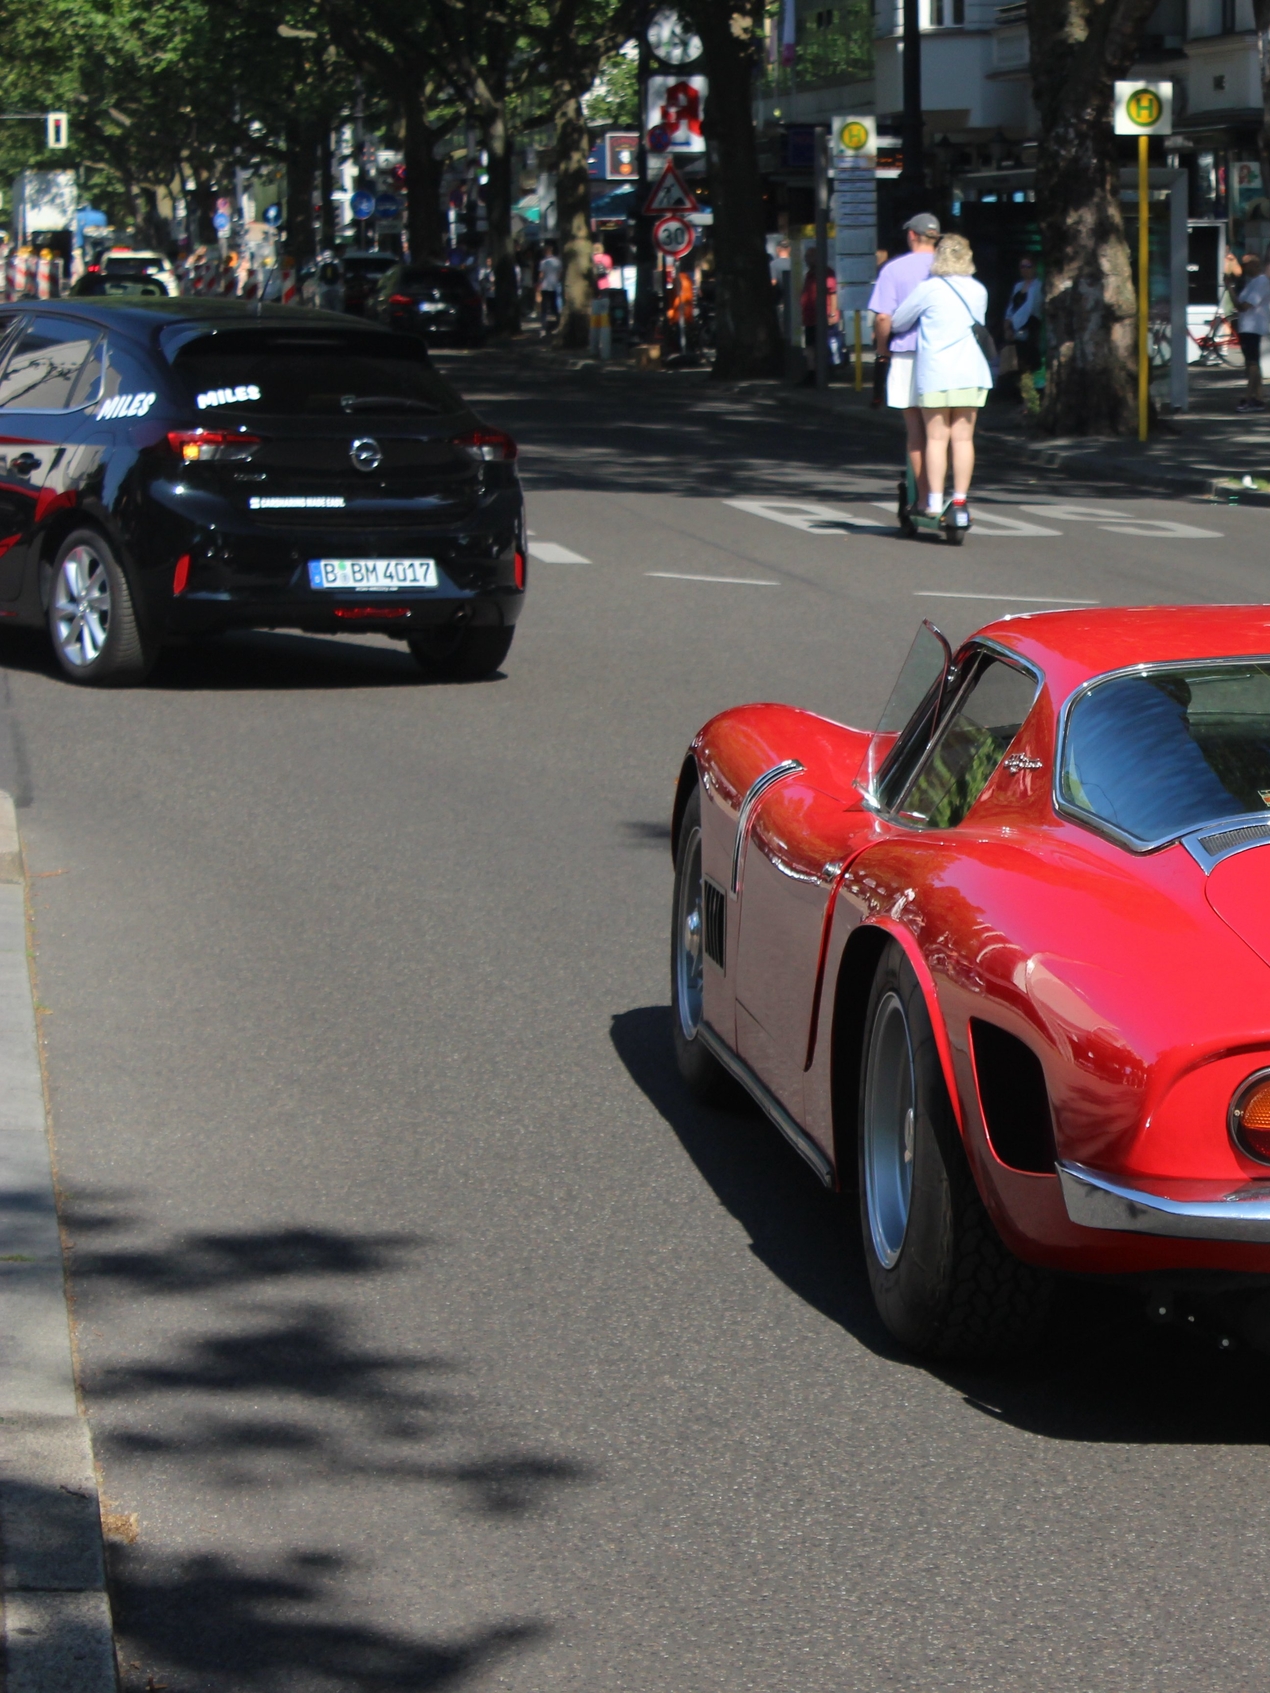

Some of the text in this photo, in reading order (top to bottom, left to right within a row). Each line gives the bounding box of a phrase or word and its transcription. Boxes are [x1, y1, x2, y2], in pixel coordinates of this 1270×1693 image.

[662, 228, 685, 246] 30
[96, 392, 157, 421] MILES
[197, 385, 261, 409] MILES
[323, 562, 430, 584] B BM 4017
